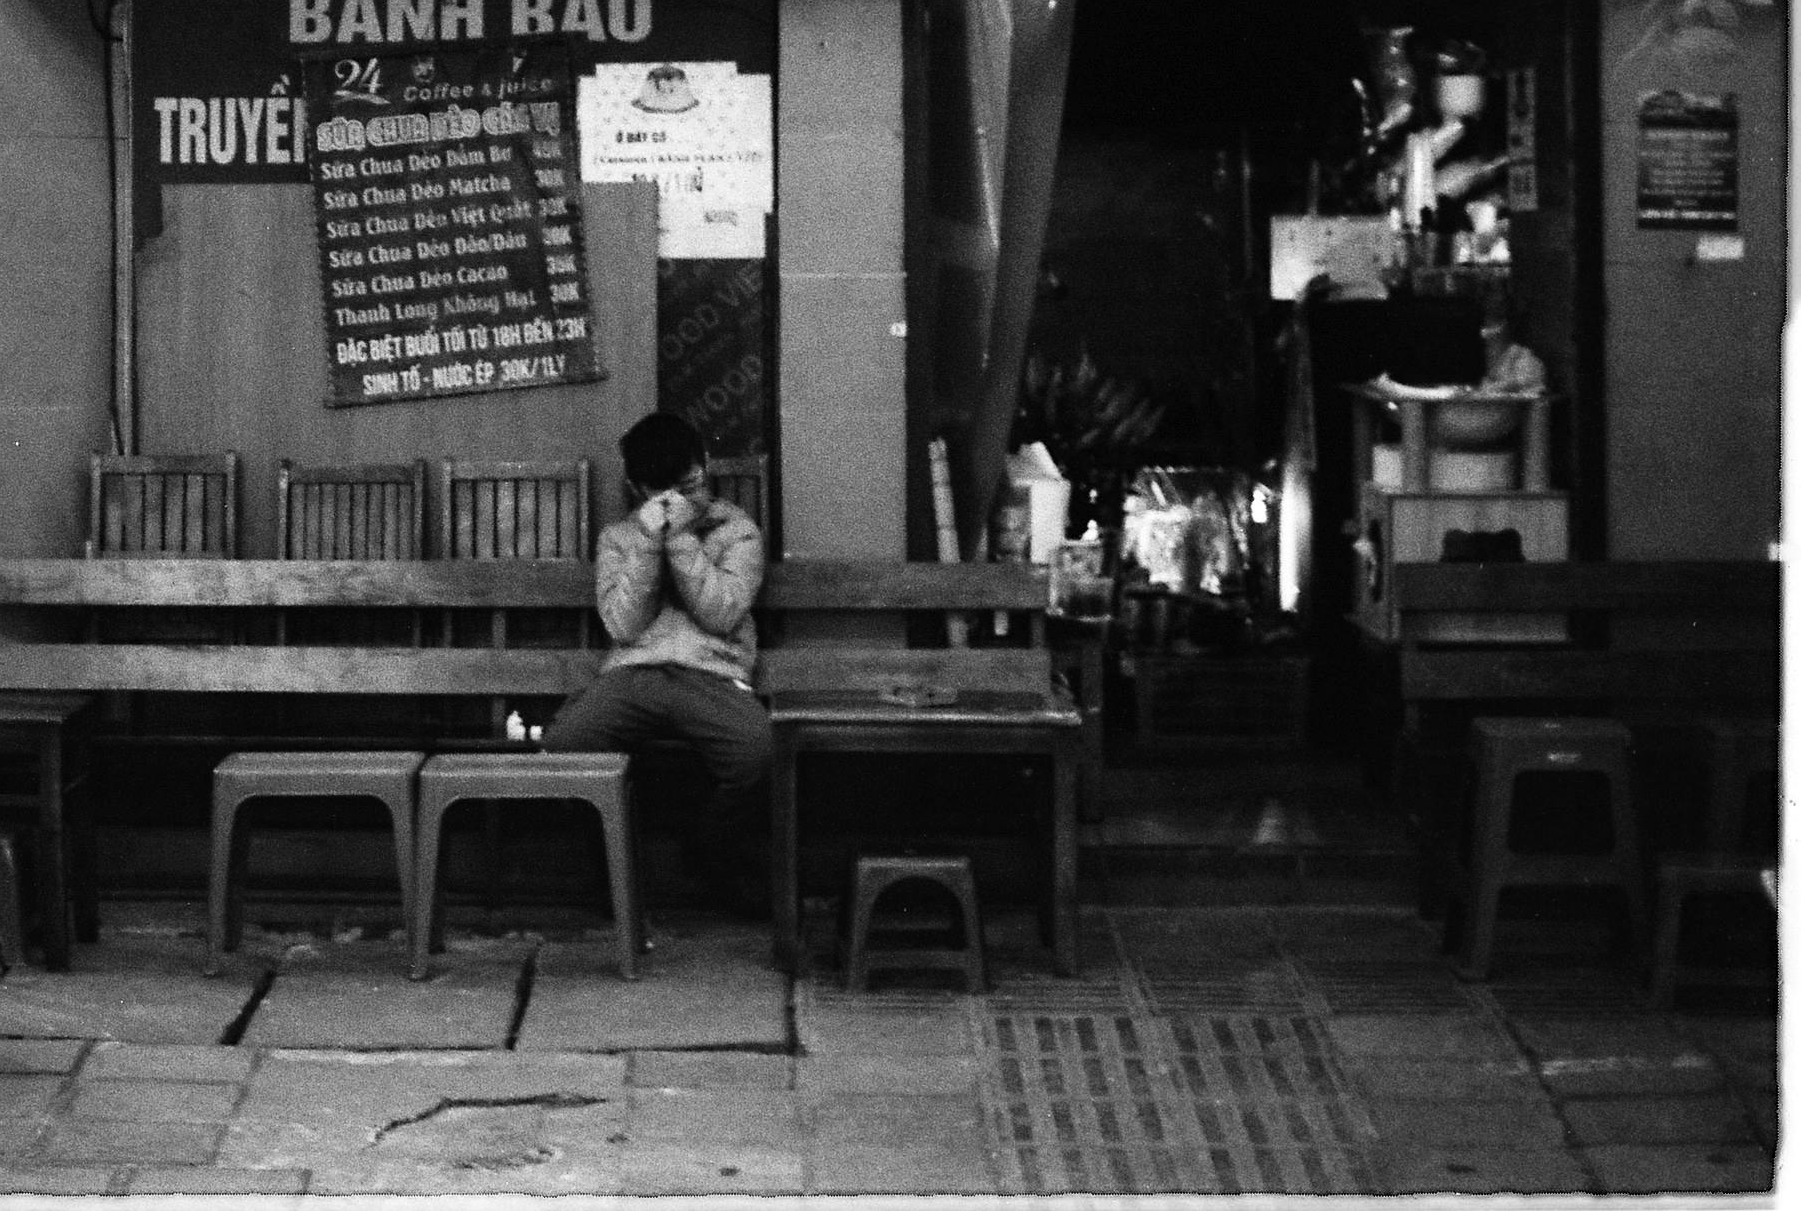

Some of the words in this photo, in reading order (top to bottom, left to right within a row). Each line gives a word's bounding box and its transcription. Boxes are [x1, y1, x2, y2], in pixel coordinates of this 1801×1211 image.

[334, 58, 382, 94] 24
[403, 82, 474, 102] Coffee
[366, 112, 429, 147] CHUA
[360, 157, 404, 177] Chua
[362, 186, 406, 206] Chua
[449, 173, 511, 196] Matcha
[365, 216, 409, 235] Chua
[368, 244, 412, 264] Chua
[371, 274, 415, 294] Chua
[456, 265, 508, 285] Cacao
[335, 303, 390, 326] Thanh
[395, 302, 438, 321] Long
[362, 372, 399, 396] SINH
[400, 363, 421, 392] TỐ
